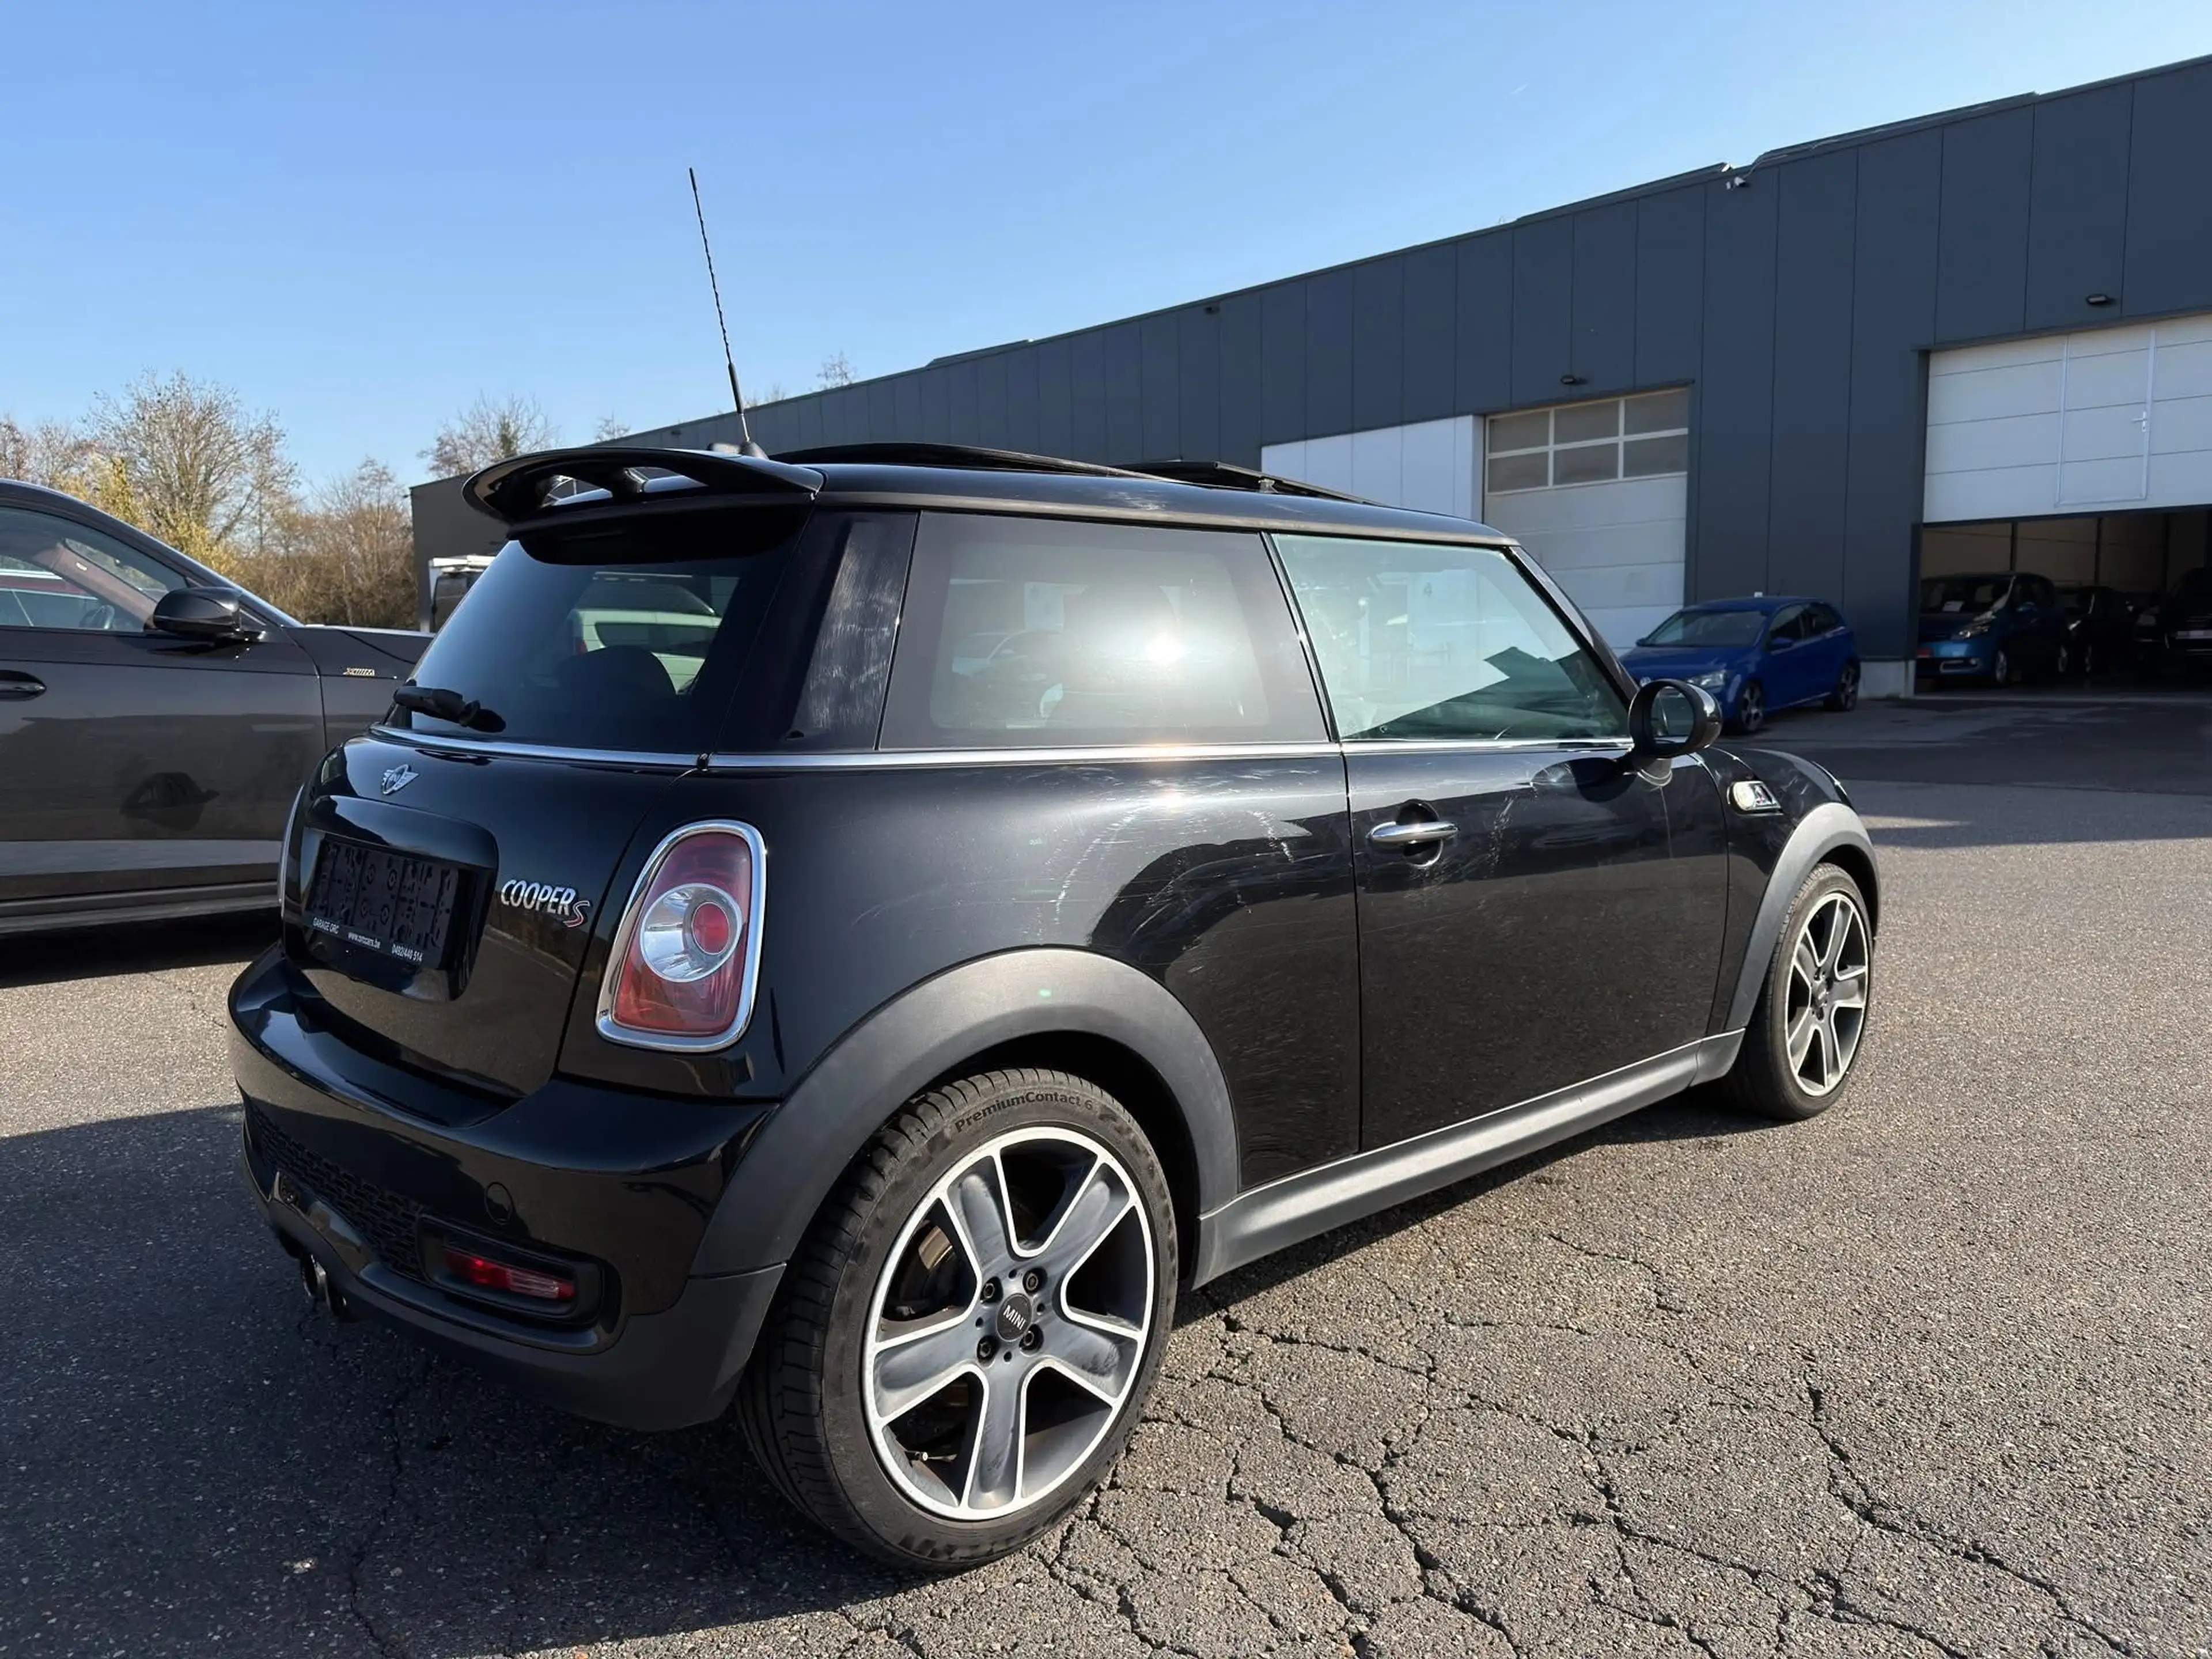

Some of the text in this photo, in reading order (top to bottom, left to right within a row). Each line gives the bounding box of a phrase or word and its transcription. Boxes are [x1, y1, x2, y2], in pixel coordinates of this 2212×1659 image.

[500, 878, 590, 928] COOPER S
[313, 916, 330, 931] GARAGE
[954, 1091, 1094, 1133] PremiumContact 6
[1003, 1304, 1027, 1331] MINI
